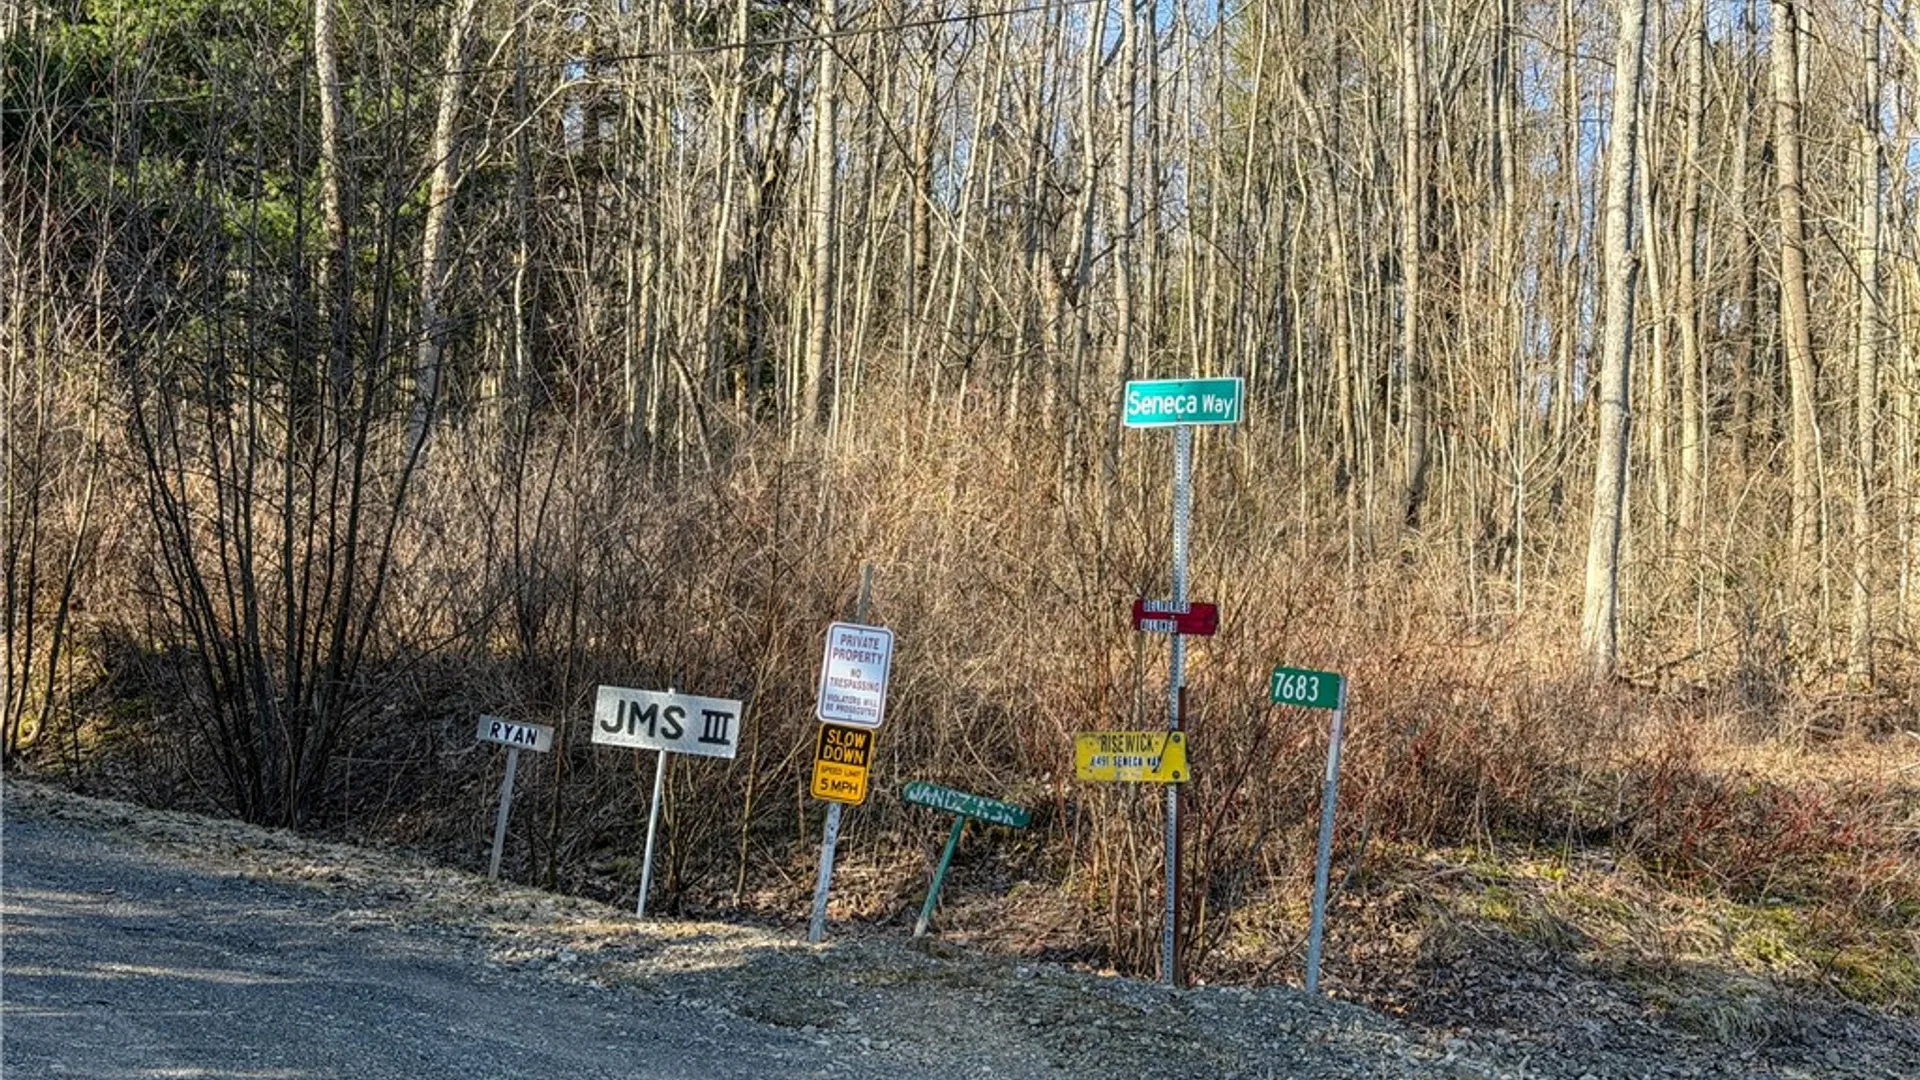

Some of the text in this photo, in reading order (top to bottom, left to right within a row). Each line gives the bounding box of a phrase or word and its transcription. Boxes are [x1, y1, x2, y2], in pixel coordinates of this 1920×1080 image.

[1128, 391, 1233, 419] Seneca Way
[840, 633, 880, 650] PRIVATE
[832, 647, 884, 664] PROPERTY
[850, 668, 862, 678] NO
[829, 676, 879, 693] TRESPASSING
[1275, 672, 1319, 702] 7683
[600, 699, 734, 745] JMS III
[490, 722, 538, 745] RYAN
[827, 729, 867, 748] SLOW
[823, 745, 864, 764] DOWN
[820, 778, 858, 794] 5 MPH
